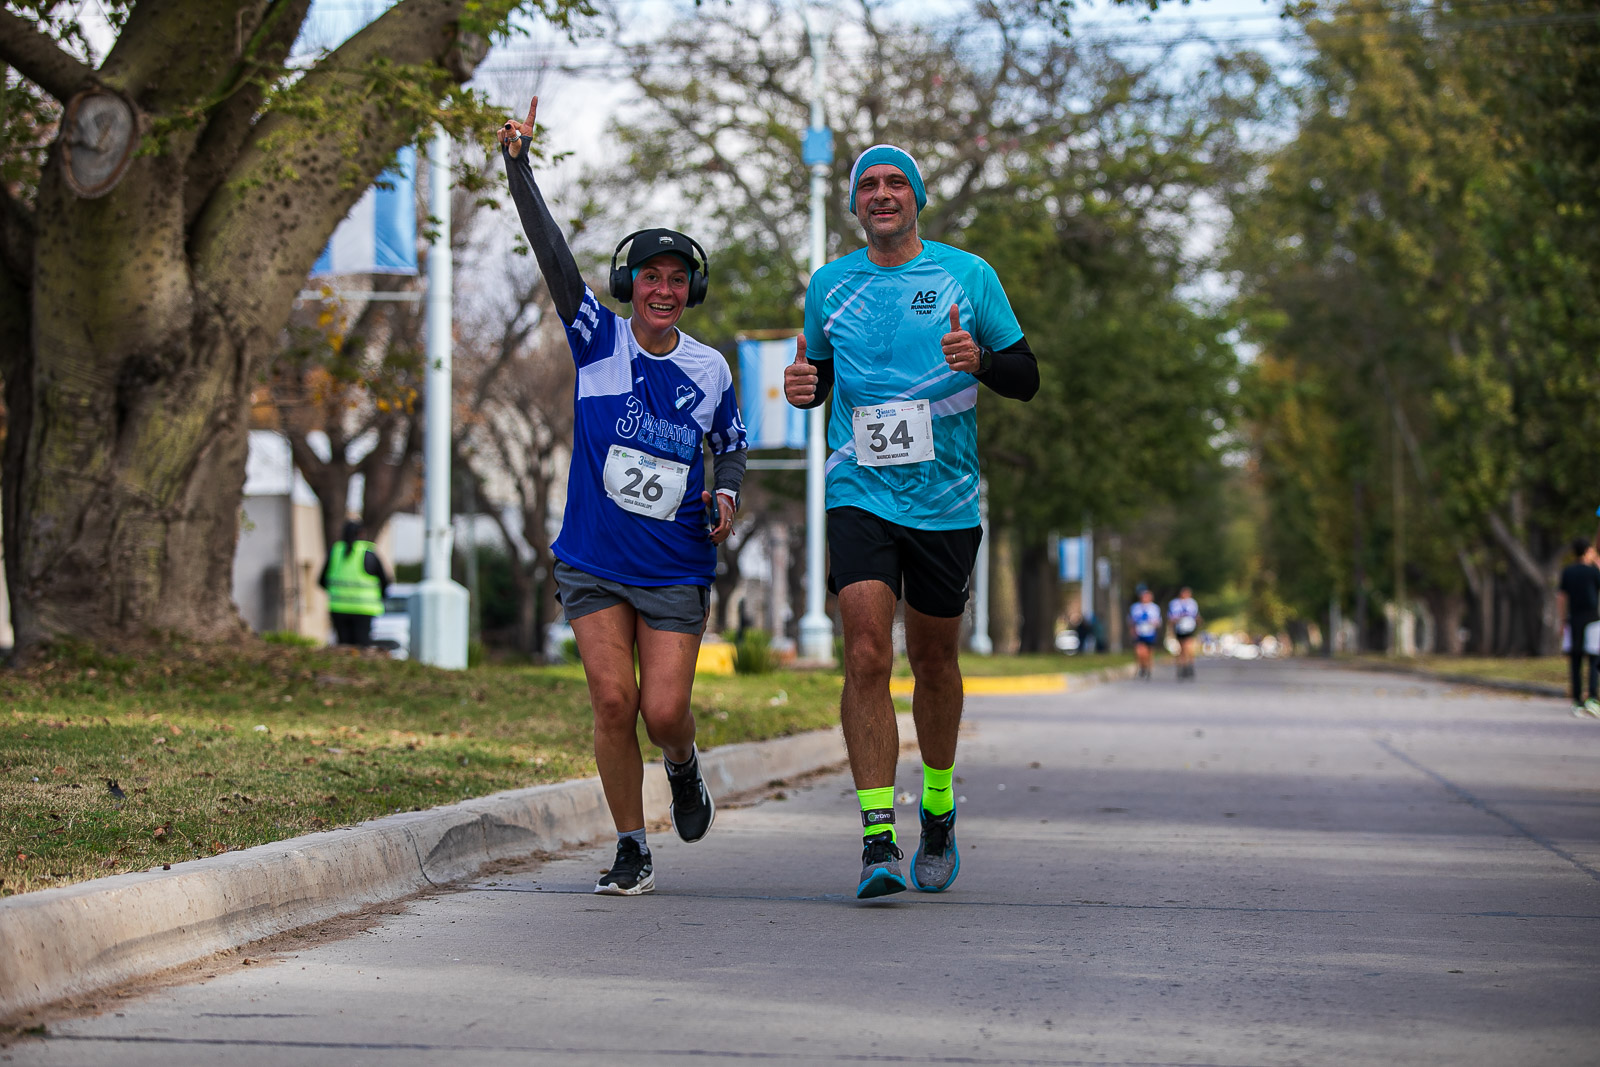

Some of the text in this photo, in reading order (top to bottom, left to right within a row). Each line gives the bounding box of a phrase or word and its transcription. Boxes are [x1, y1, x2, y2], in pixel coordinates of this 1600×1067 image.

[911, 290, 937, 304] AG
[615, 395, 697, 448] 3 MARATÓN
[866, 420, 914, 452] 34
[620, 467, 664, 502] 26
